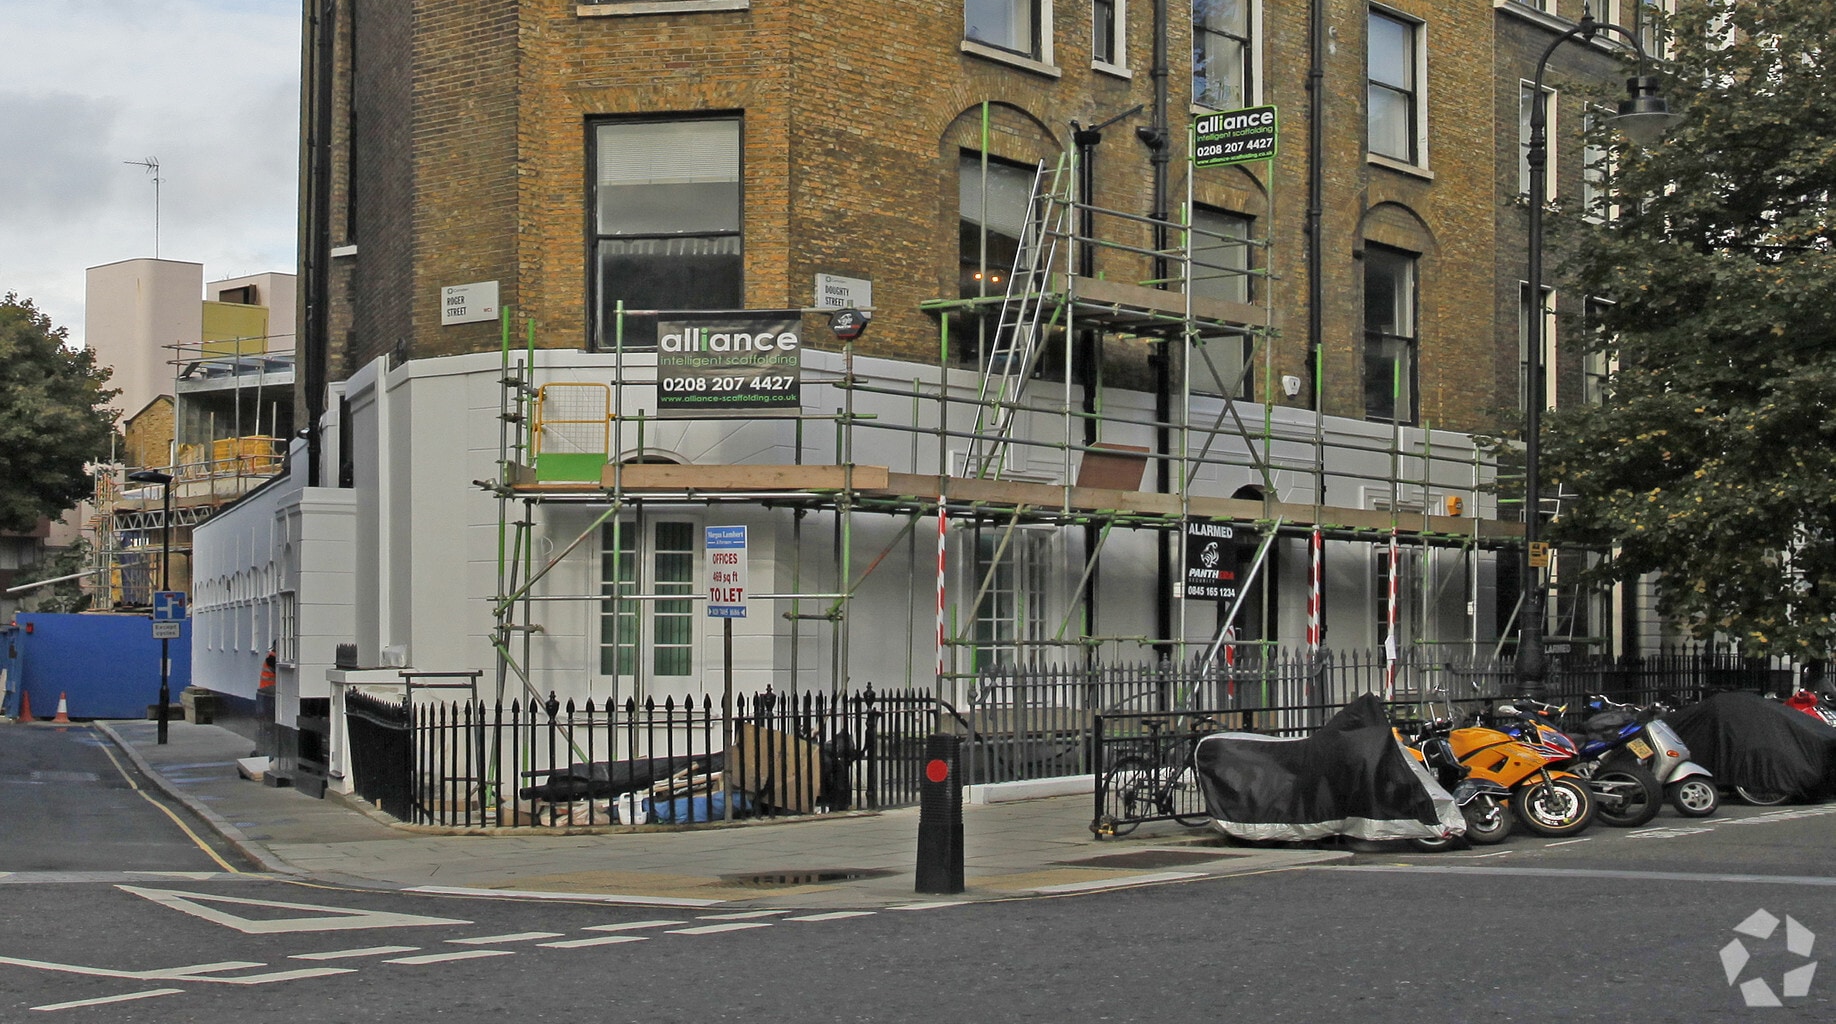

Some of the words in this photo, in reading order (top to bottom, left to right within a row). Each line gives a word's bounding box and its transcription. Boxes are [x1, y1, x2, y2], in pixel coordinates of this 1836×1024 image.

[1197, 112, 1274, 134] alliance
[1197, 131, 1231, 142] intelligent
[1232, 126, 1273, 137] scaffolding
[1197, 145, 1222, 156] 0208
[1225, 141, 1244, 153] 207
[1246, 137, 1273, 150] 4427
[825, 285, 849, 296] DOUGHTY
[447, 296, 464, 306] ROGER
[825, 296, 844, 306] STREET
[447, 307, 466, 317] STREET
[660, 327, 798, 352] alliance
[660, 356, 722, 367] intelligent
[725, 355, 798, 366] scaffolding
[663, 377, 707, 391] 0208
[711, 377, 745, 391] 207
[750, 376, 794, 390] 4427
[660, 394, 797, 403] www.alliance-scaffolding.co.uk
[1188, 523, 1233, 539] ALARMED
[712, 553, 738, 565] OFFICES
[723, 573, 731, 585] sq
[732, 571, 738, 582] ft
[710, 587, 721, 602] TO
[723, 587, 743, 602] LET
[1543, 644, 1571, 654] LARMED
